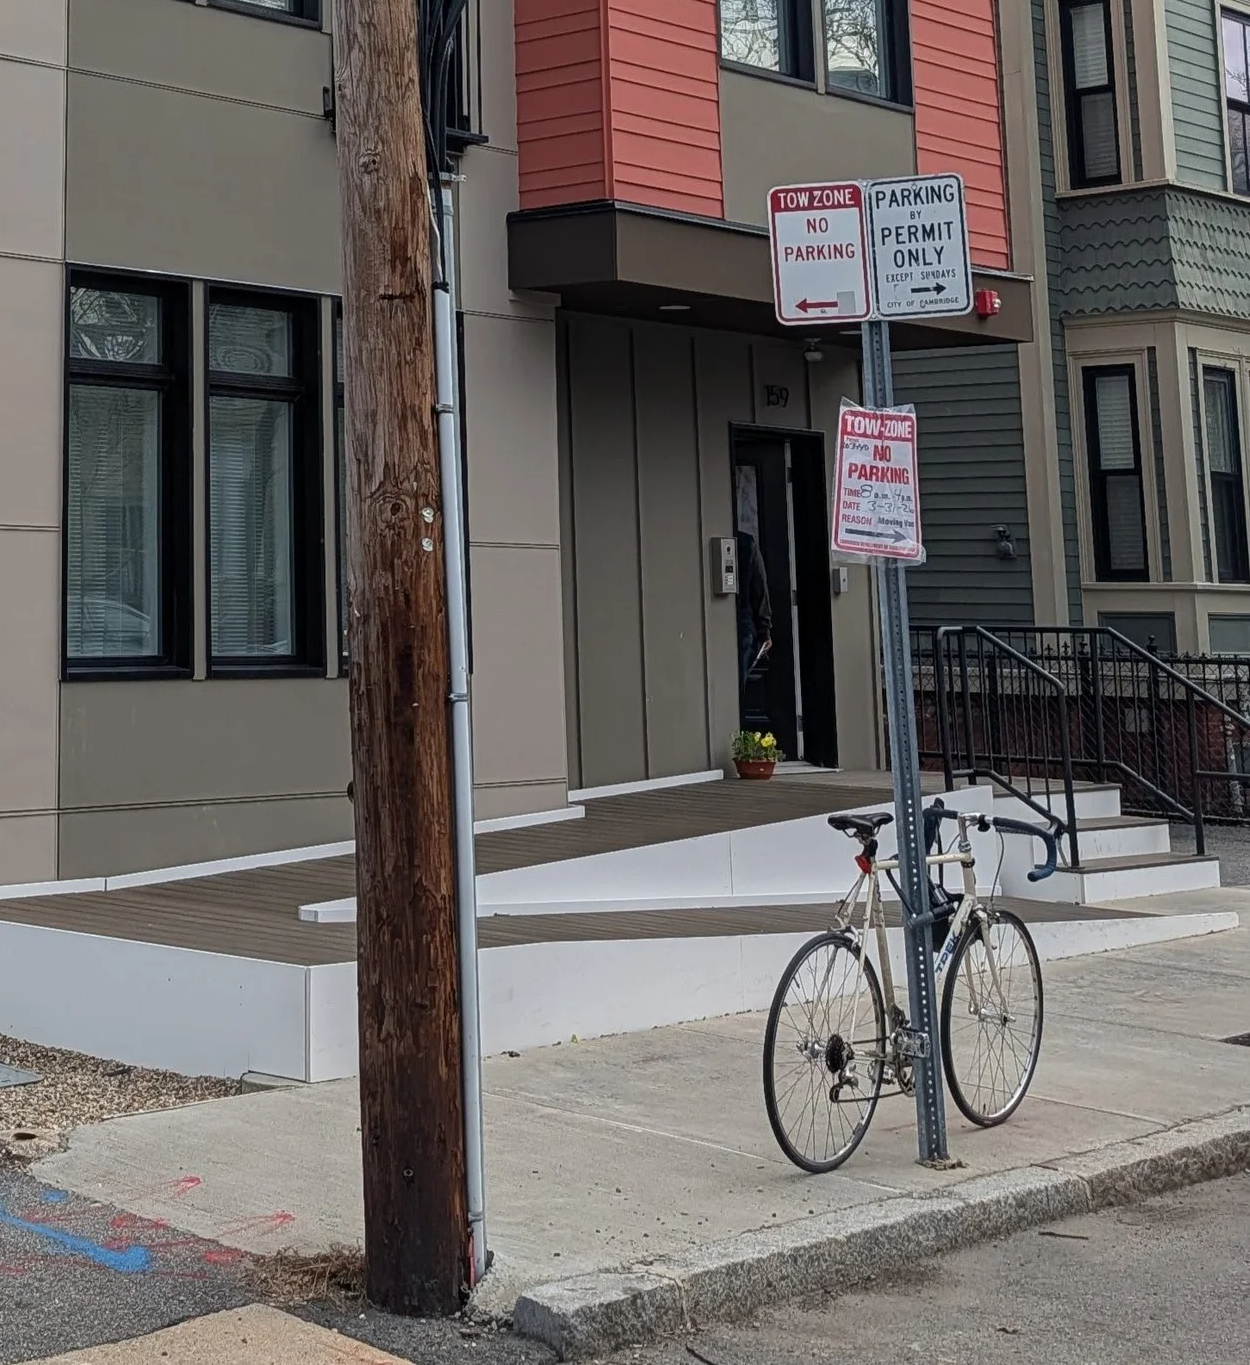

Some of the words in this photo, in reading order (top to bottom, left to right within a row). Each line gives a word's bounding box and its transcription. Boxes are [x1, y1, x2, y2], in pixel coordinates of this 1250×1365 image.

[778, 191, 809, 209] TOW
[814, 189, 855, 207] ZONE
[875, 184, 955, 209] PARKING
[910, 210, 922, 220] BY
[806, 218, 829, 234] NO
[881, 221, 954, 246] PERMIT
[784, 243, 855, 262] PARKING
[894, 246, 945, 268] ONLY
[886, 272, 914, 283] EXCEPT
[921, 269, 956, 281] SUNDAYS
[887, 301, 901, 309] CITY
[920, 297, 959, 309] CAMBRIDGE
[764, 385, 790, 408] 159
[873, 445, 891, 462] NO
[848, 462, 910, 485] PARKING
[844, 487, 861, 498] TIME
[842, 501, 861, 511] DATE
[842, 514, 872, 525] REASON
